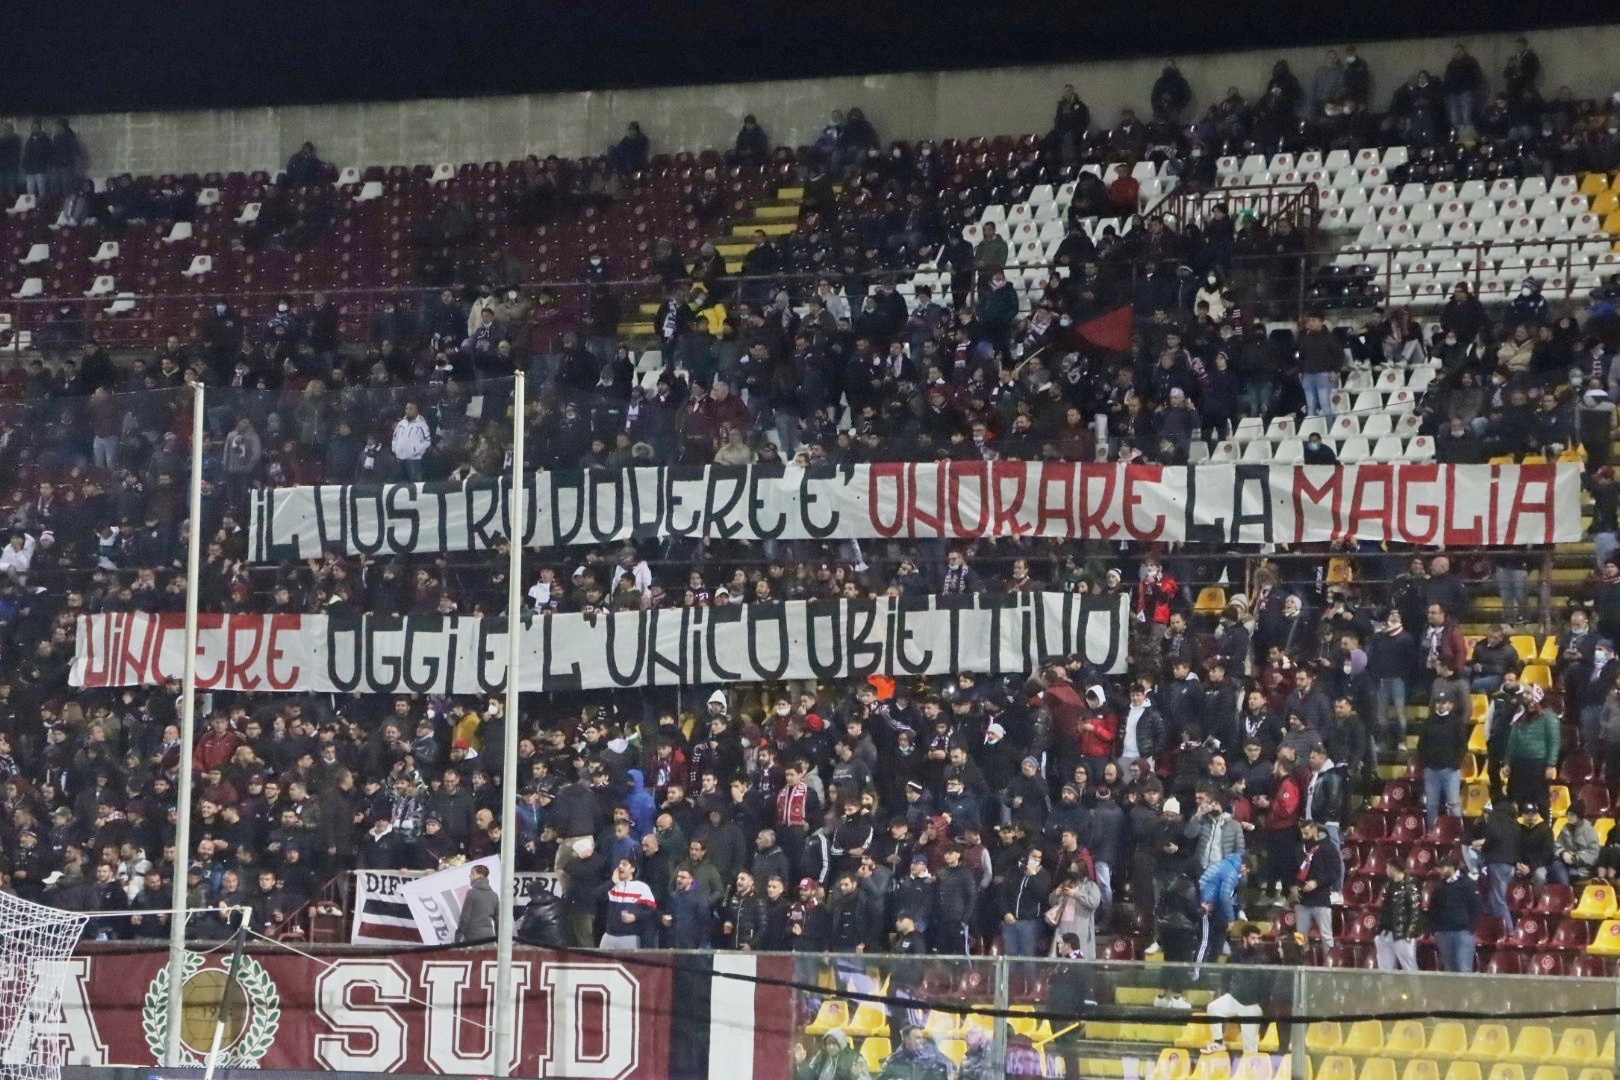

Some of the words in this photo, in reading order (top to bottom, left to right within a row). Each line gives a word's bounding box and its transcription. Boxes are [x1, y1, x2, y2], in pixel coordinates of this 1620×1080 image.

[550, 465, 786, 547] DOVERE
[868, 461, 1166, 541] ONORARE
[1185, 465, 1274, 543] LA
[314, 958, 640, 1079] SUD
